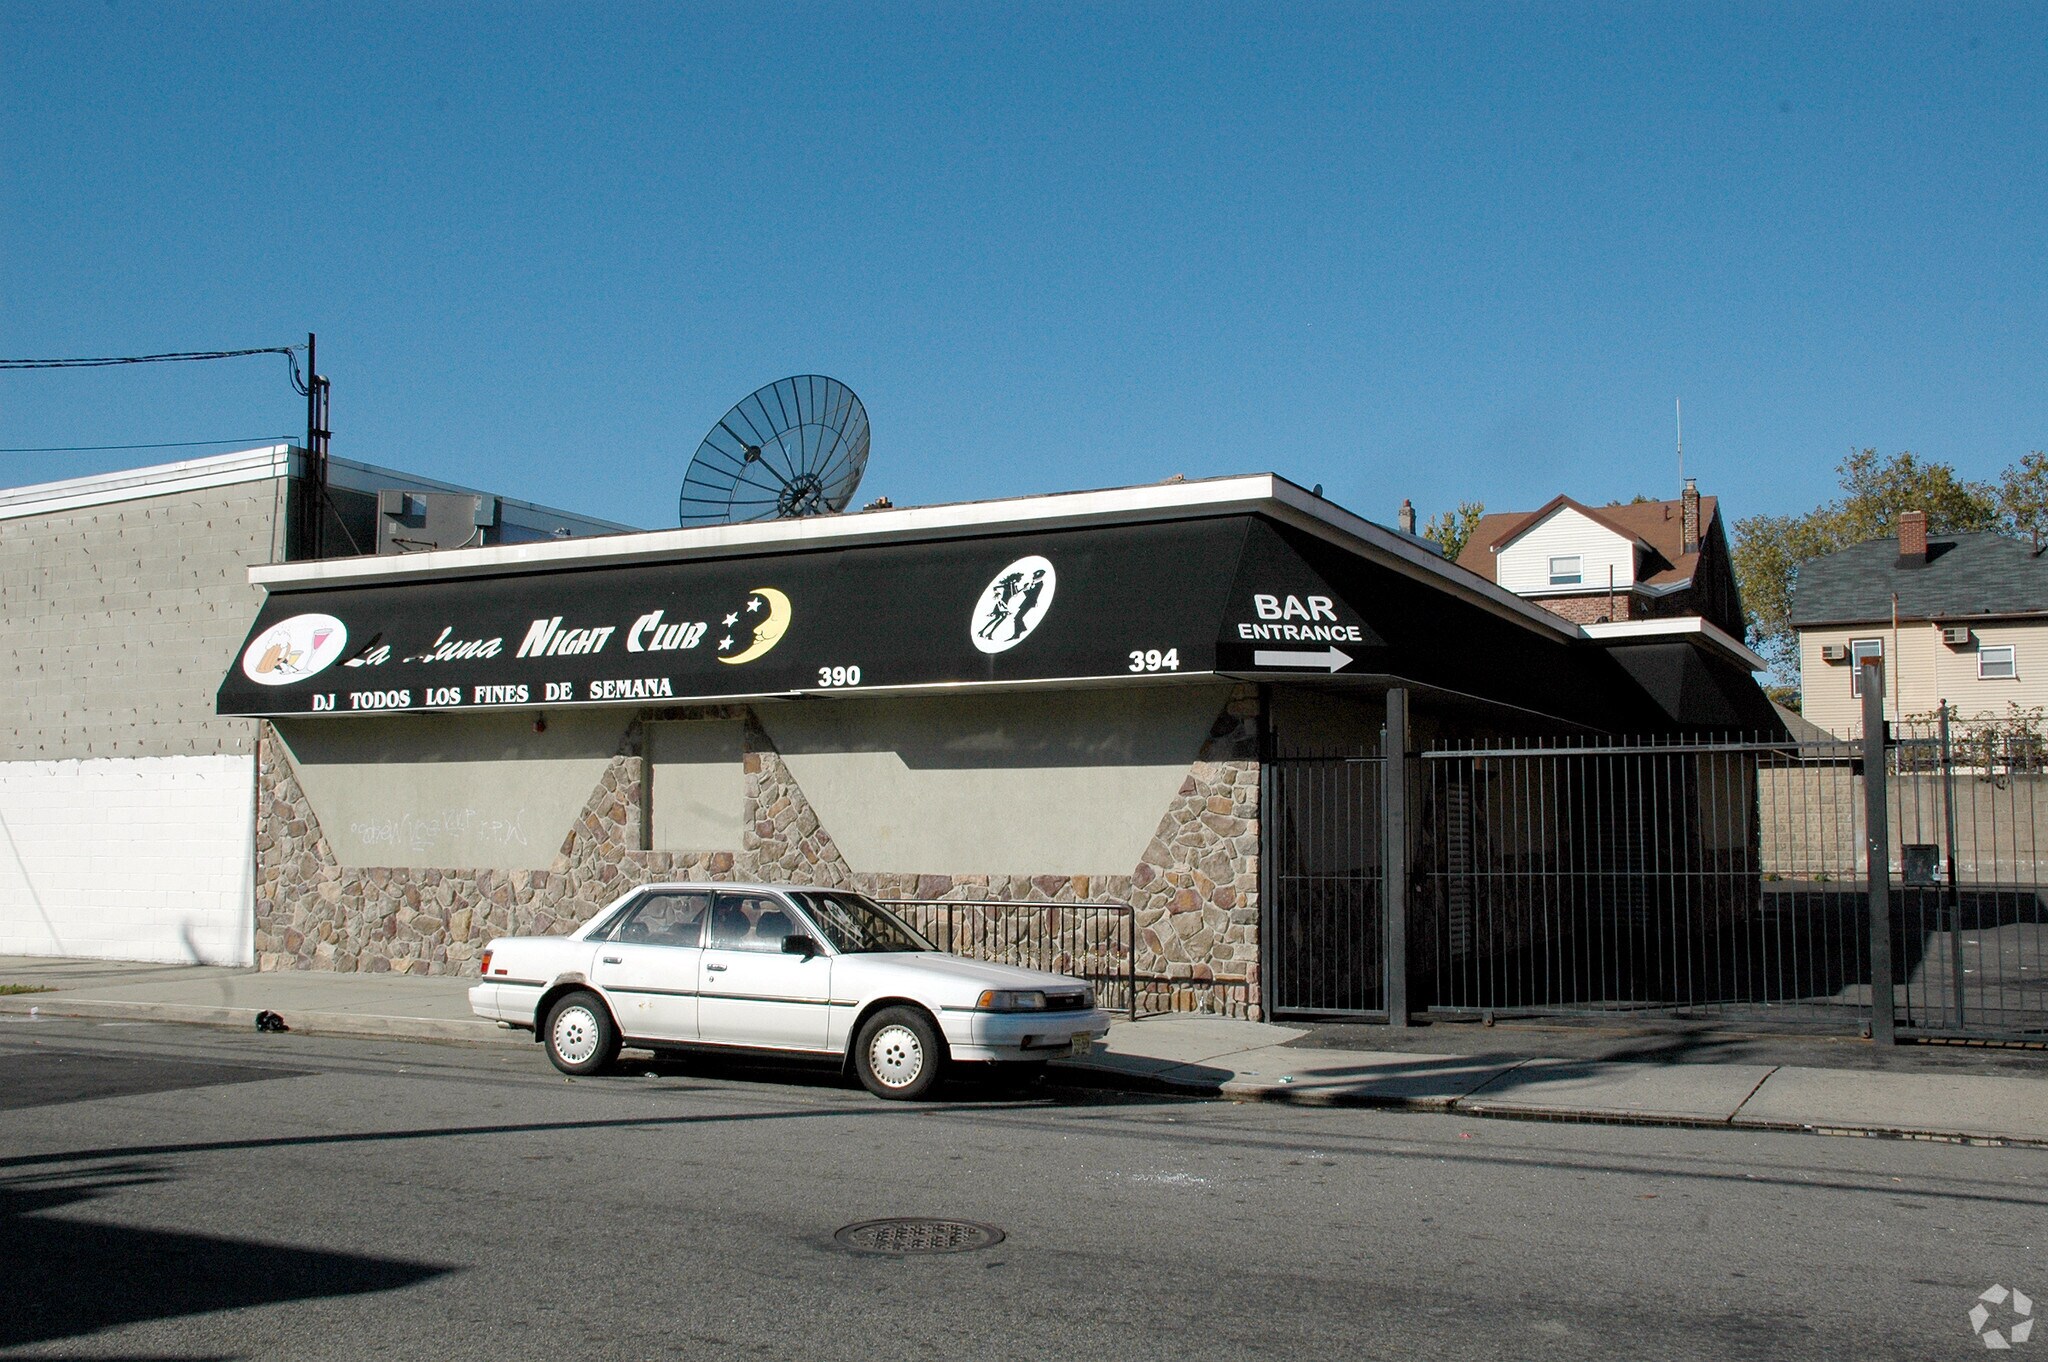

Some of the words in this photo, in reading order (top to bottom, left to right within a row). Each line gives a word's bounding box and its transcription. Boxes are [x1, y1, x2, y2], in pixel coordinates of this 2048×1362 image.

[1253, 593, 1338, 622] BAR
[1237, 622, 1363, 643] ENTRANCE
[1128, 647, 1181, 674] 394
[817, 665, 862, 688] 390
[312, 693, 337, 713] DJ
[349, 689, 411, 711] TODOS
[425, 686, 462, 706] LOS
[473, 684, 530, 704] FINES
[544, 682, 573, 702] DE
[589, 677, 674, 701] SEMANA
